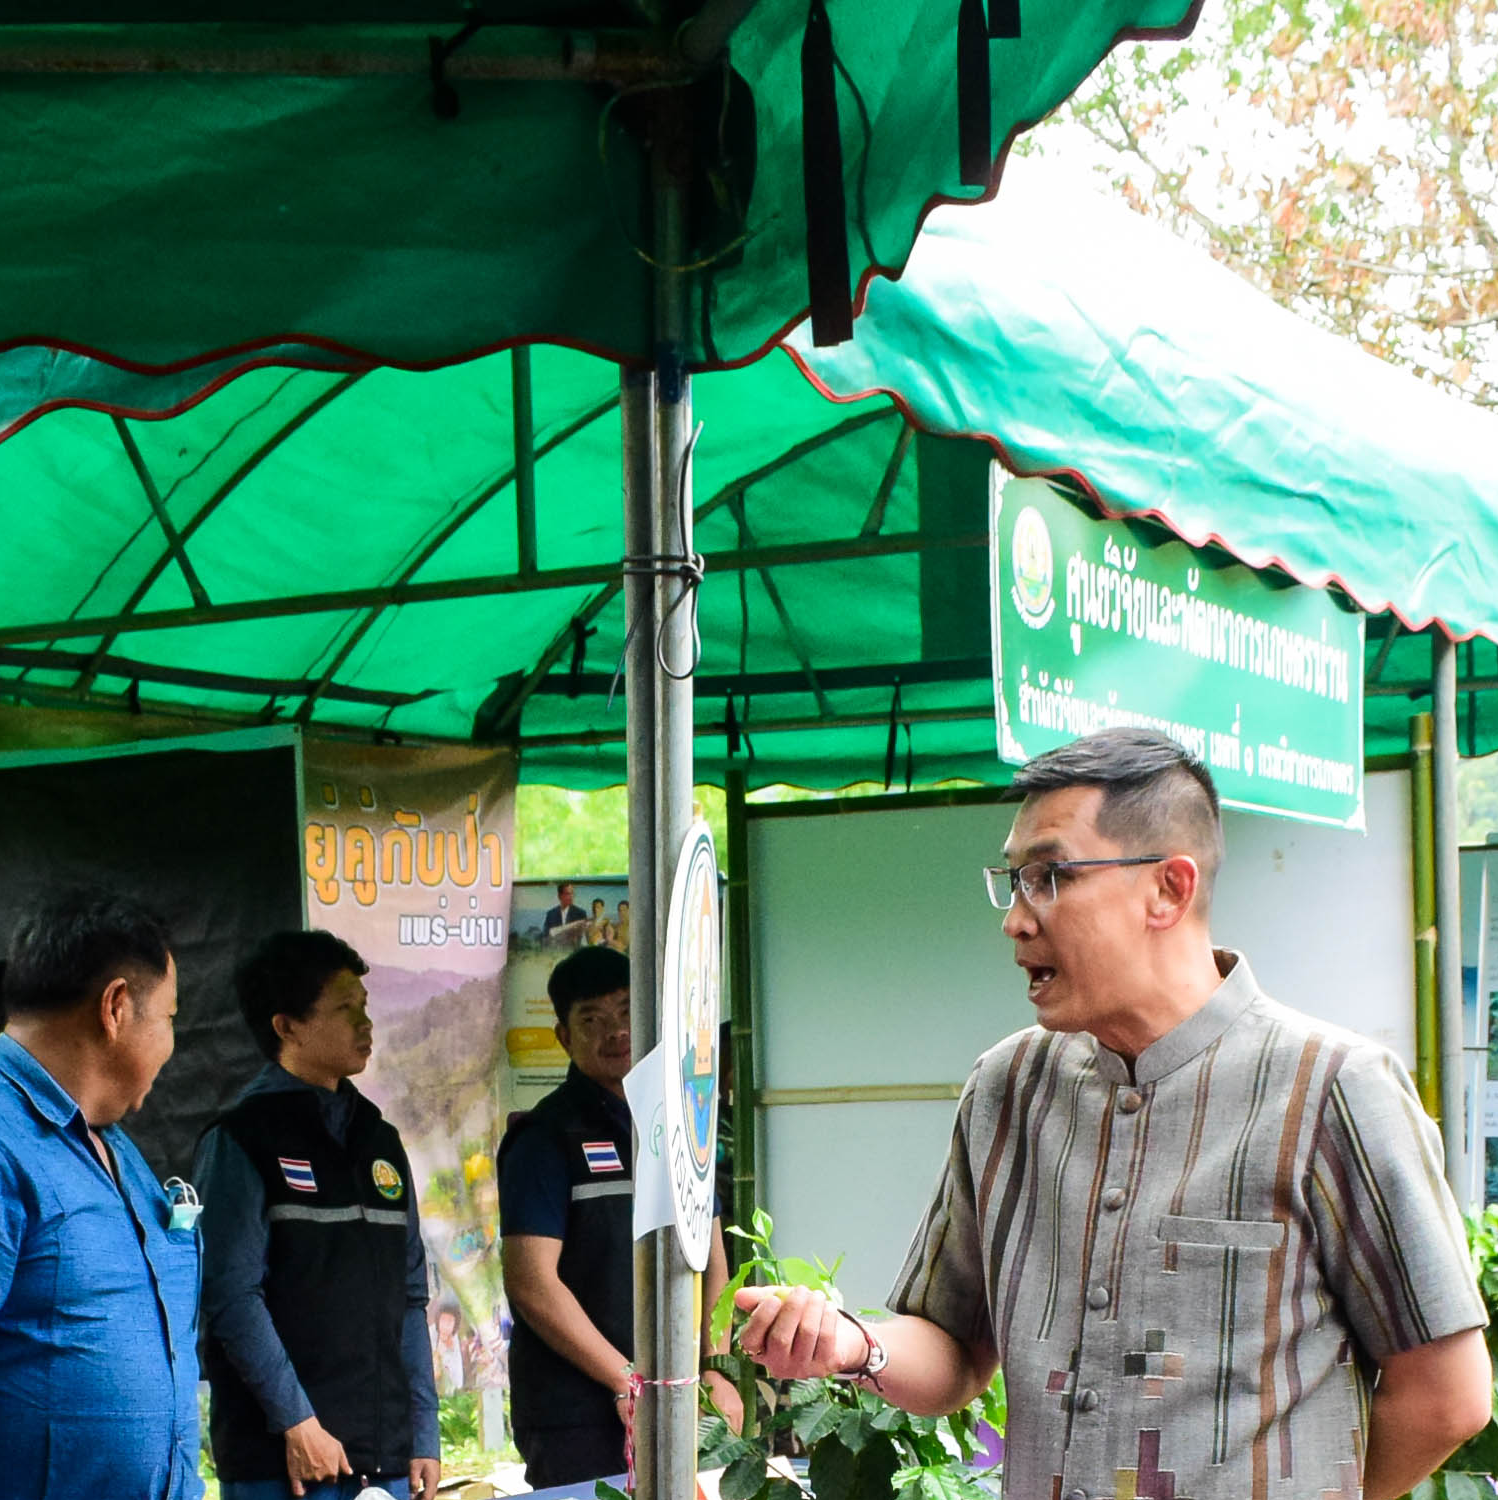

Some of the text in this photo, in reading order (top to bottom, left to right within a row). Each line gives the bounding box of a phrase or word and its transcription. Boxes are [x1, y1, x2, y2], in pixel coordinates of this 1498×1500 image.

[1065, 534, 1349, 704] ศูนย์วิจัยและพัฒนาการเกษตรน่าน
[399, 895, 503, 946] แพร่-น่าน
